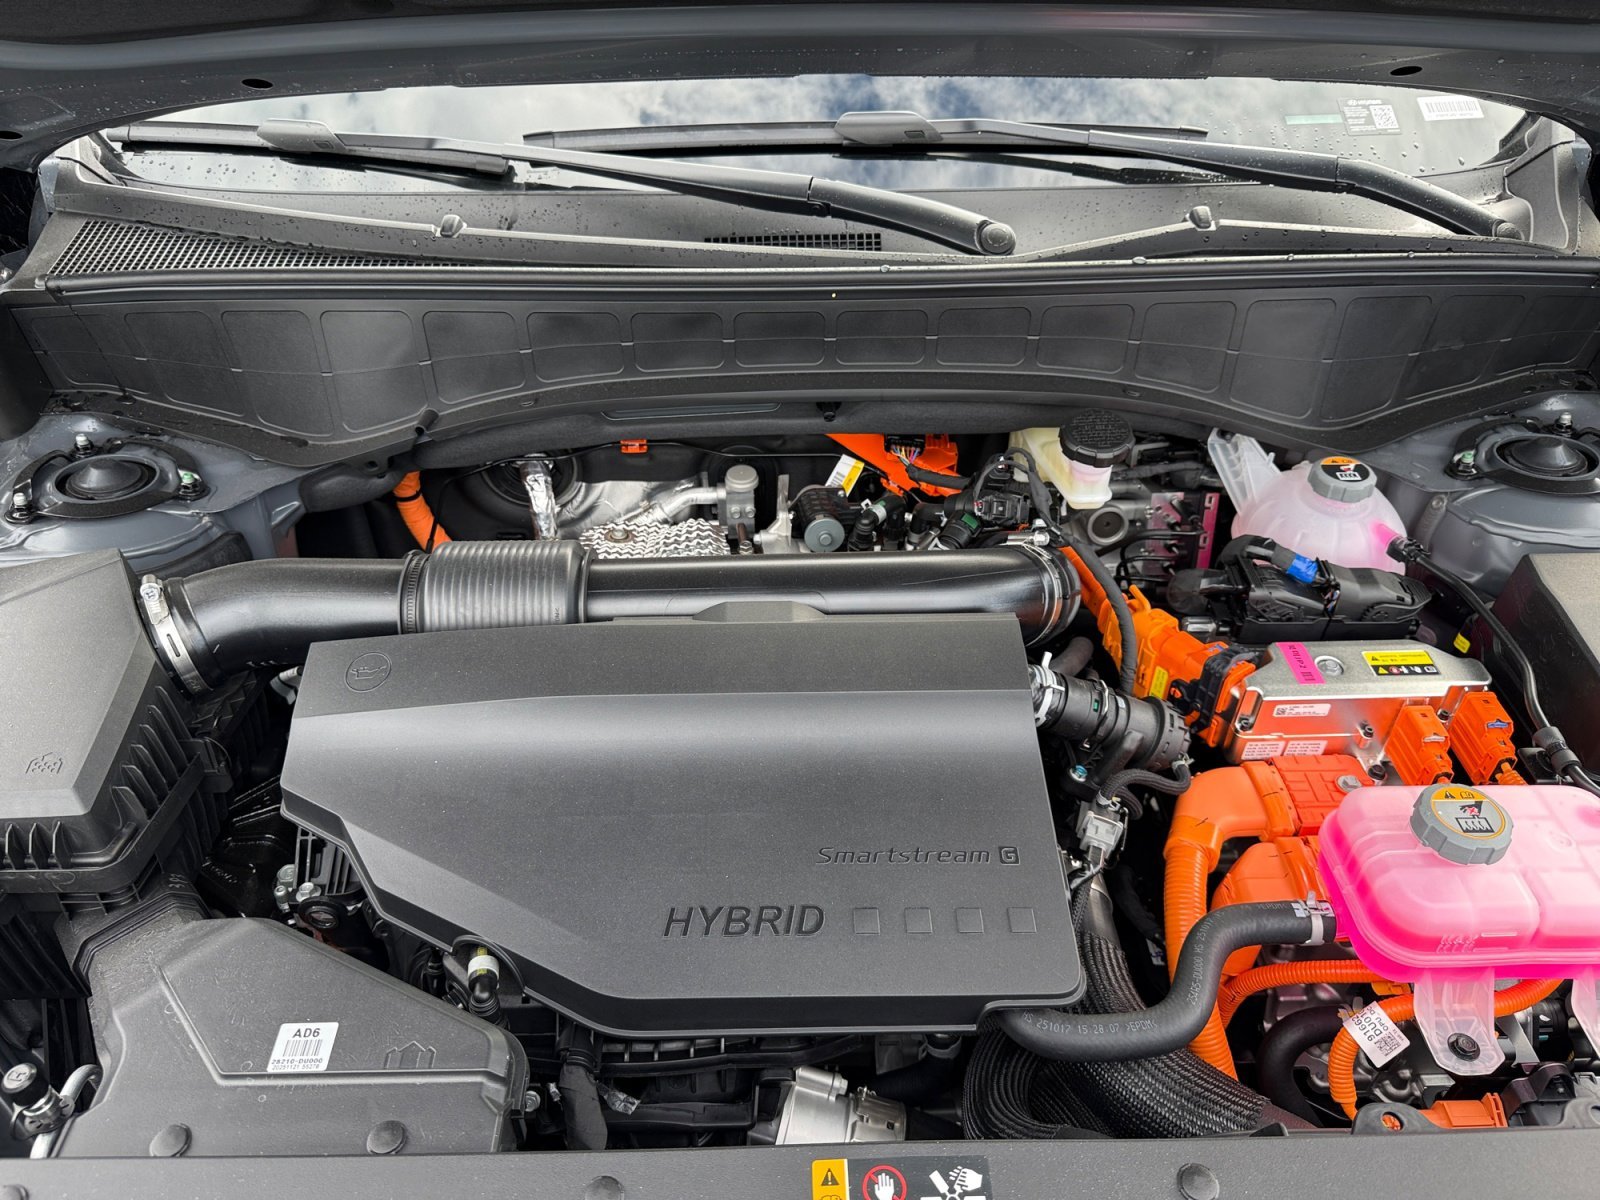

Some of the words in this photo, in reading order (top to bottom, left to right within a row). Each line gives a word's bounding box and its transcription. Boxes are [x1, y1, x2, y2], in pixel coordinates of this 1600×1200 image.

[816, 846, 990, 865] Smartstream
[999, 846, 1020, 865] G
[662, 905, 826, 938] HYBRID
[292, 1028, 321, 1038] AD6
